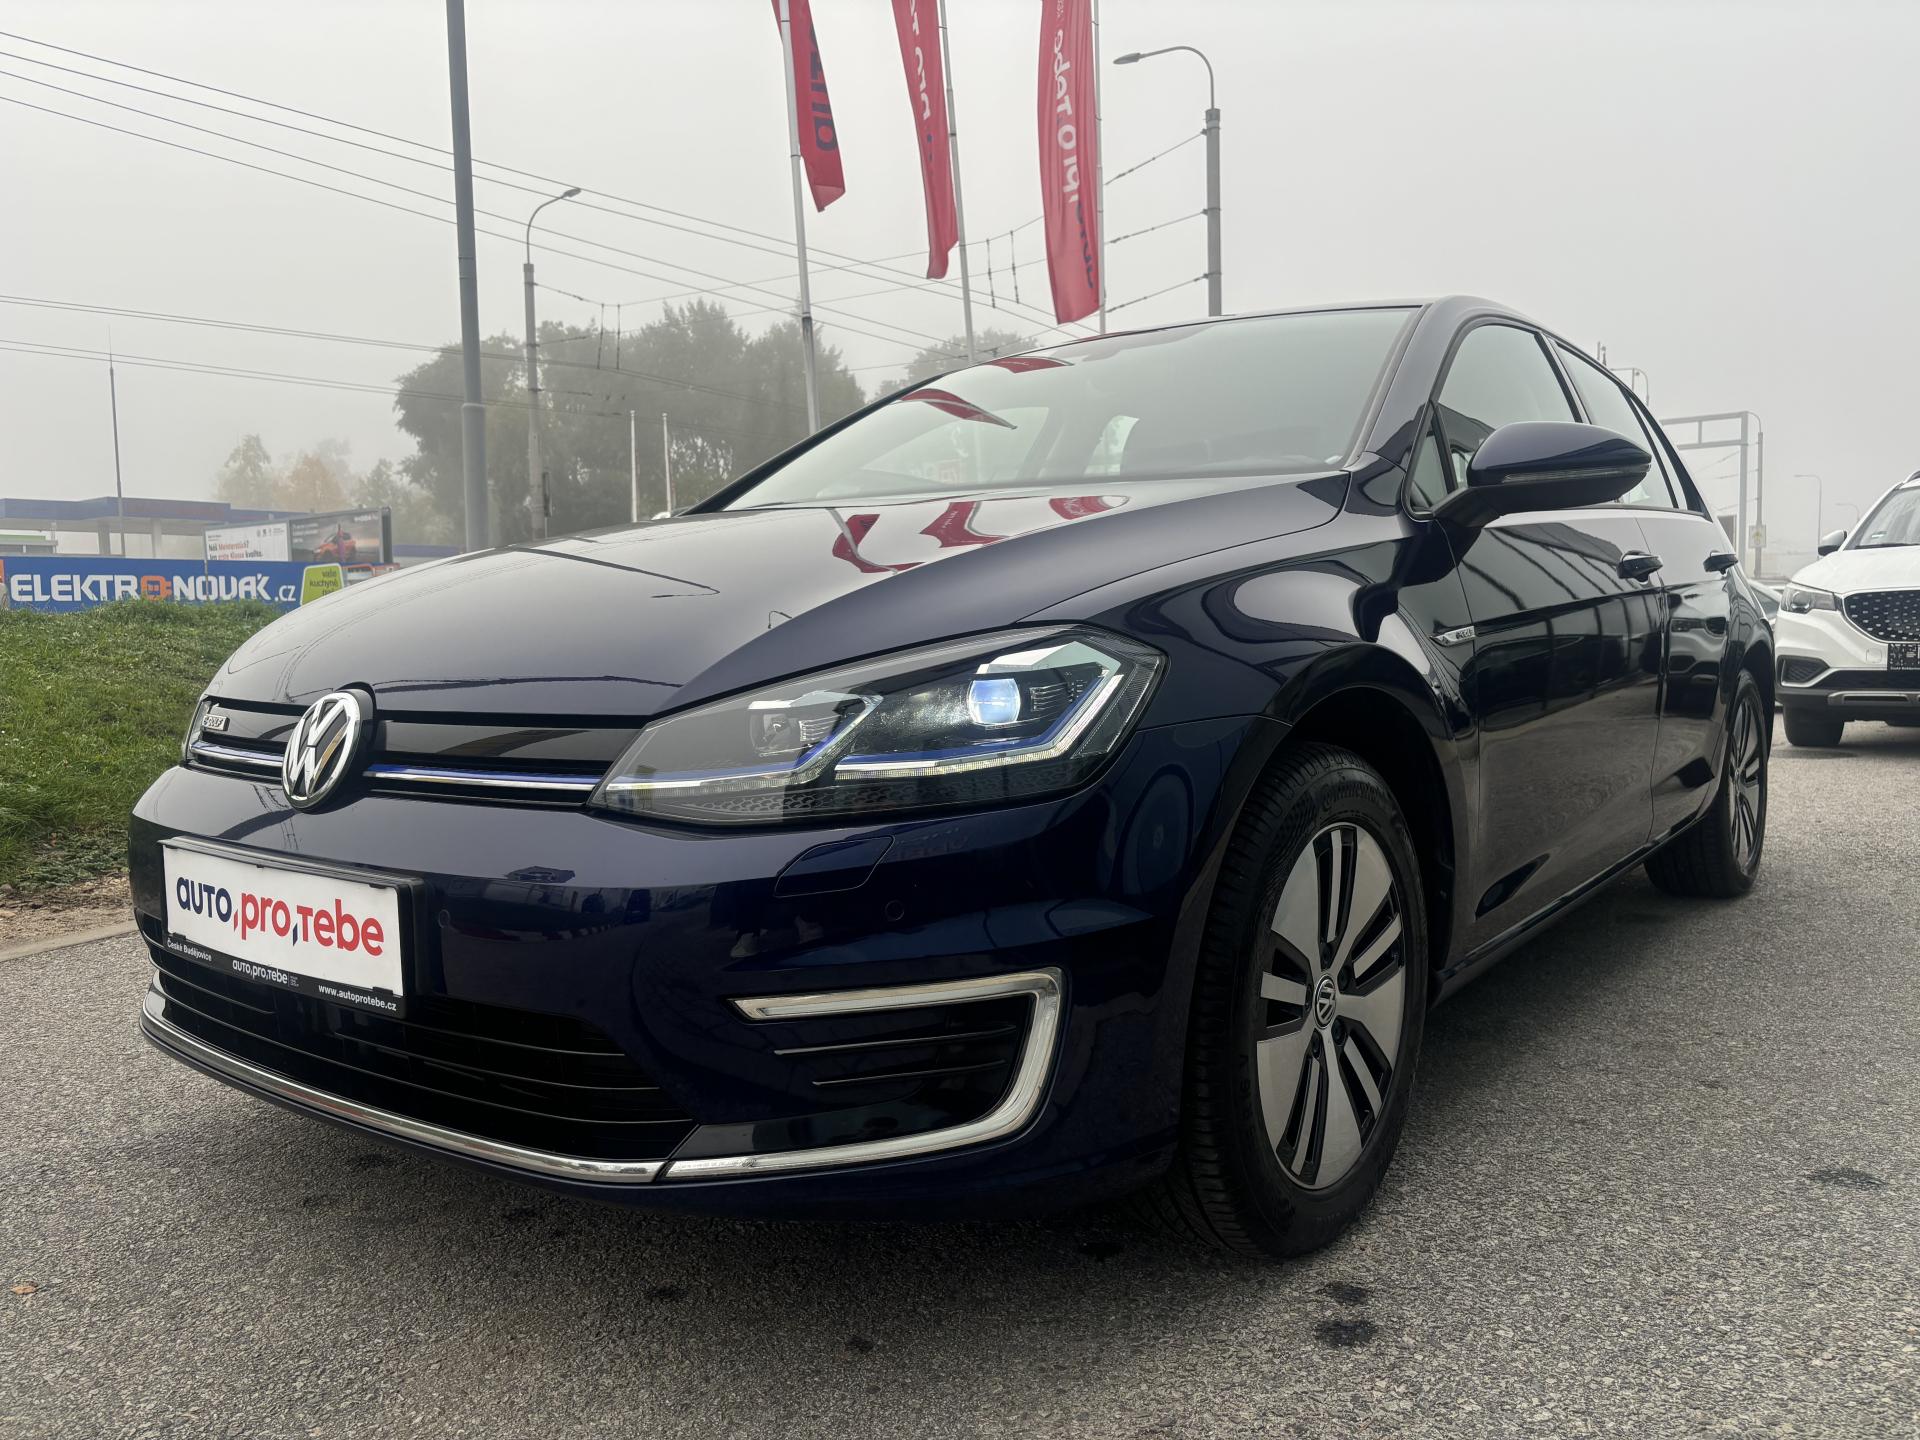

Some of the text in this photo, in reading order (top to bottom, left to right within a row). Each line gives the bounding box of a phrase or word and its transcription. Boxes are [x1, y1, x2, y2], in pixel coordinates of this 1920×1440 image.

[167, 937, 213, 962] České Budějovice
[318, 984, 397, 1012] www.autoprotebe.cz
